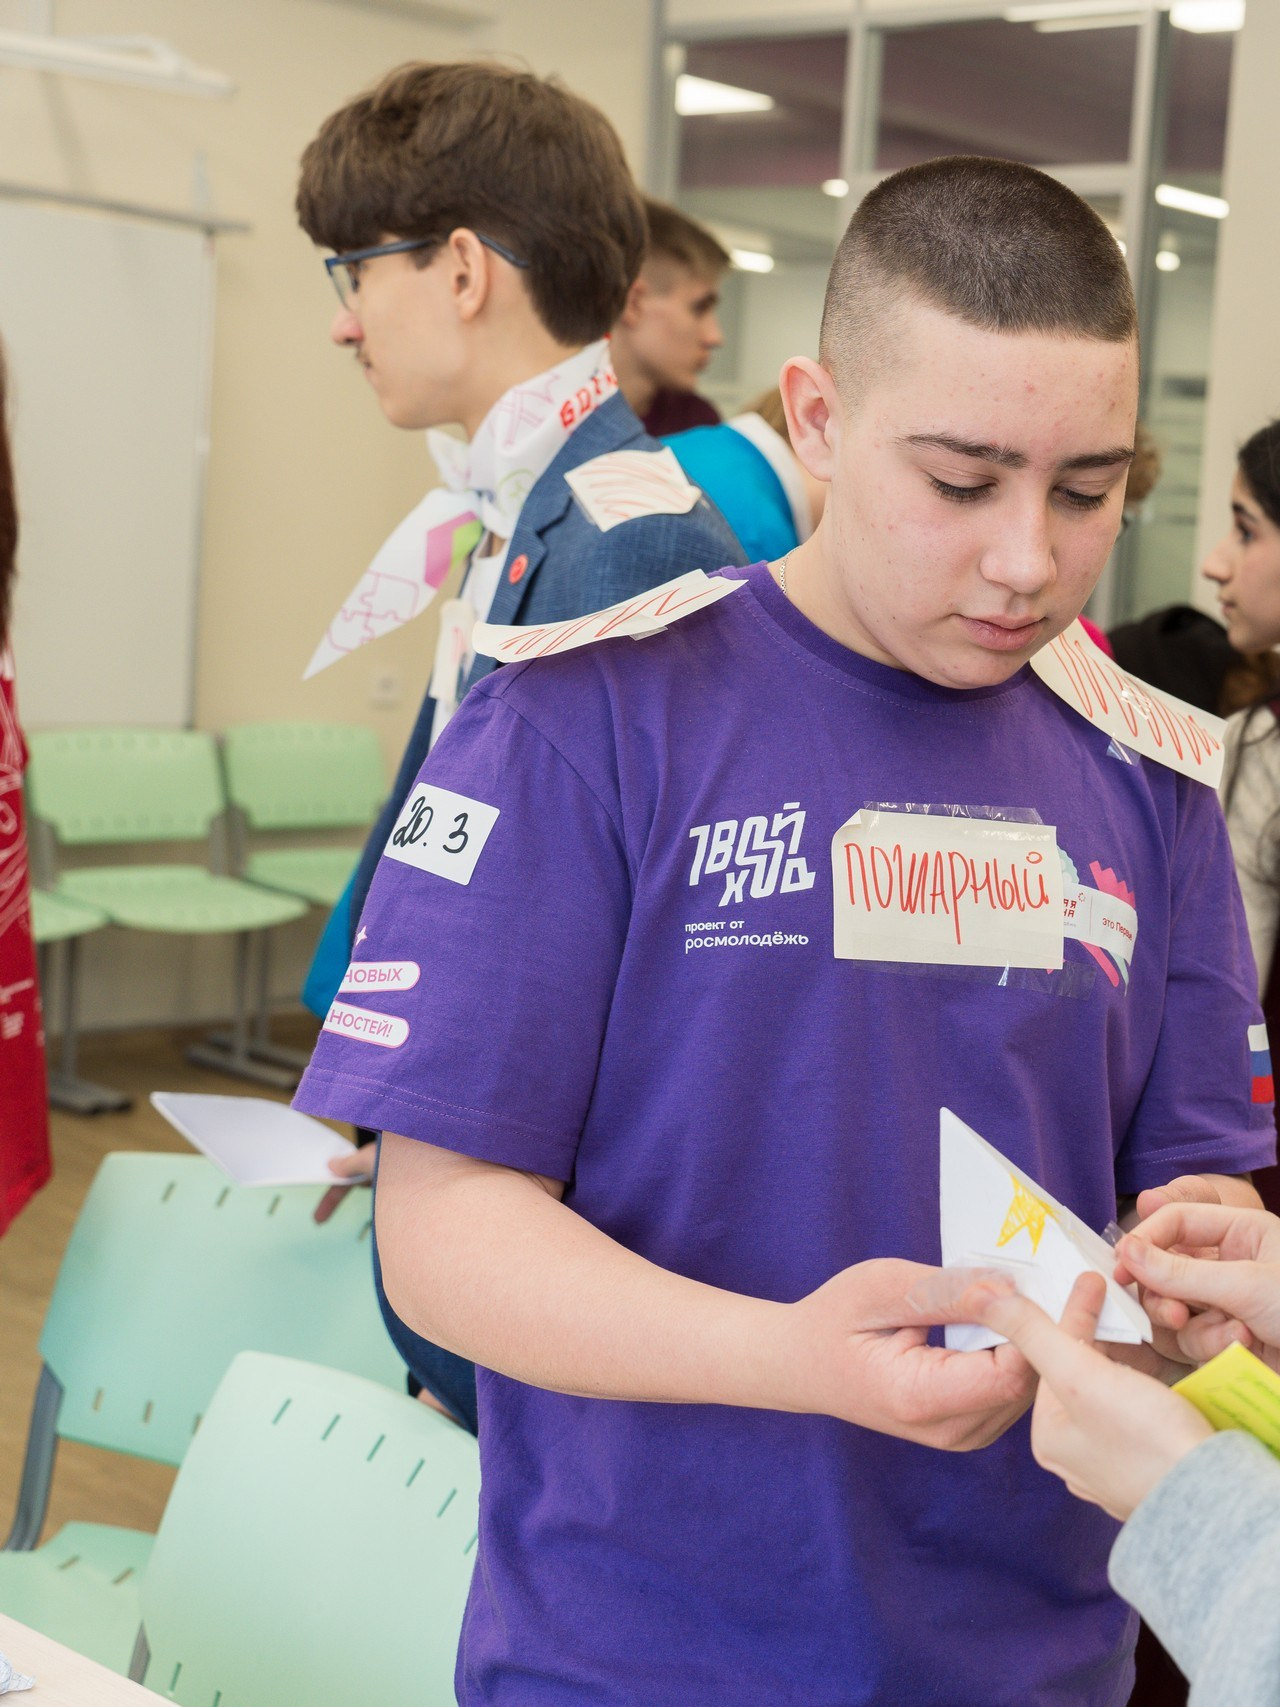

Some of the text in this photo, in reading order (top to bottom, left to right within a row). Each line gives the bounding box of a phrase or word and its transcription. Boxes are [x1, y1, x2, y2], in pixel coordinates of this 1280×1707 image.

[442, 812, 469, 854] 3
[689, 802, 807, 887] ТВОЙ
[718, 848, 816, 908] ХОД
[685, 920, 745, 934] проект от
[685, 931, 809, 954] росмолодёжь
[326, 1009, 393, 1038] НОСТЕЙ!
